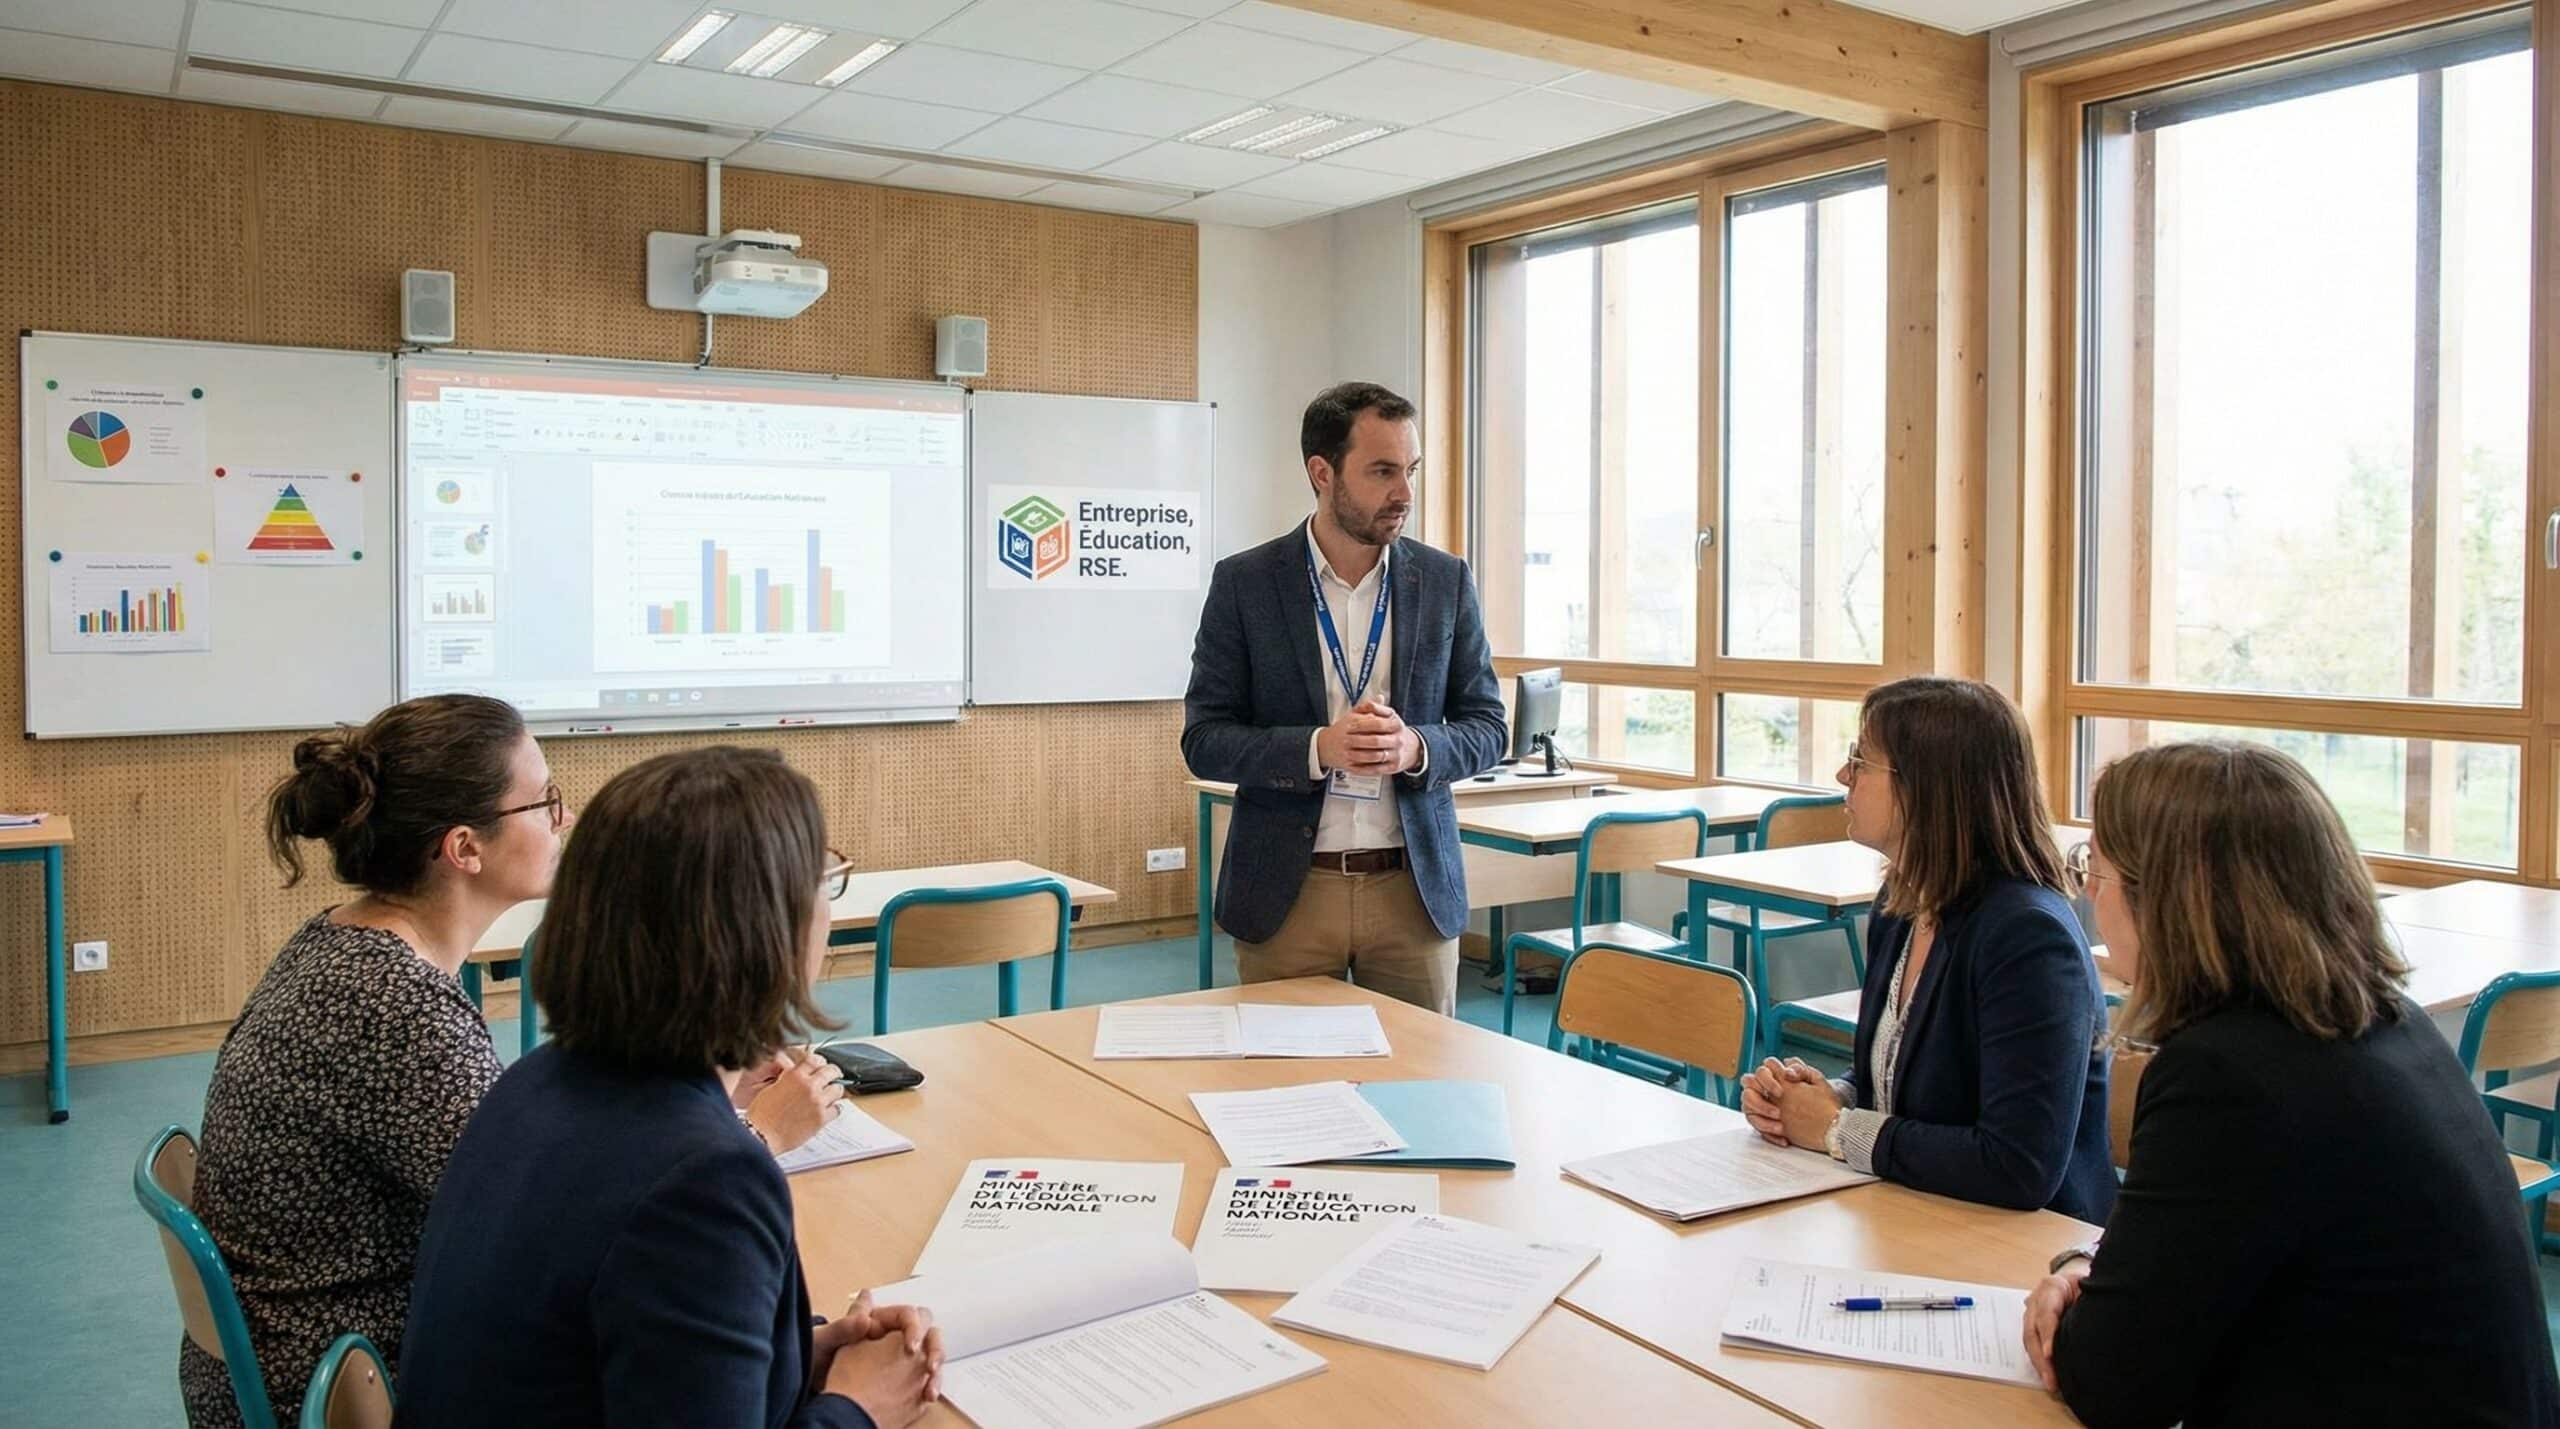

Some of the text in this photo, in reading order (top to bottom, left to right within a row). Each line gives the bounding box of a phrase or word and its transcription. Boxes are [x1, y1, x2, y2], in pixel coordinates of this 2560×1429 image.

[1079, 502, 1194, 528] Entreprise,
[1079, 525, 1192, 553] Éducation,
[1079, 557, 1128, 577] RSE.
[979, 1180, 1099, 1193] MINISTÈRE
[974, 1189, 1157, 1204] DE L'ÉDUCATION
[969, 1200, 1103, 1213] NATIONALE
[1229, 1199, 1259, 1209] DE
[1226, 1210, 1361, 1223] NATIONALE
